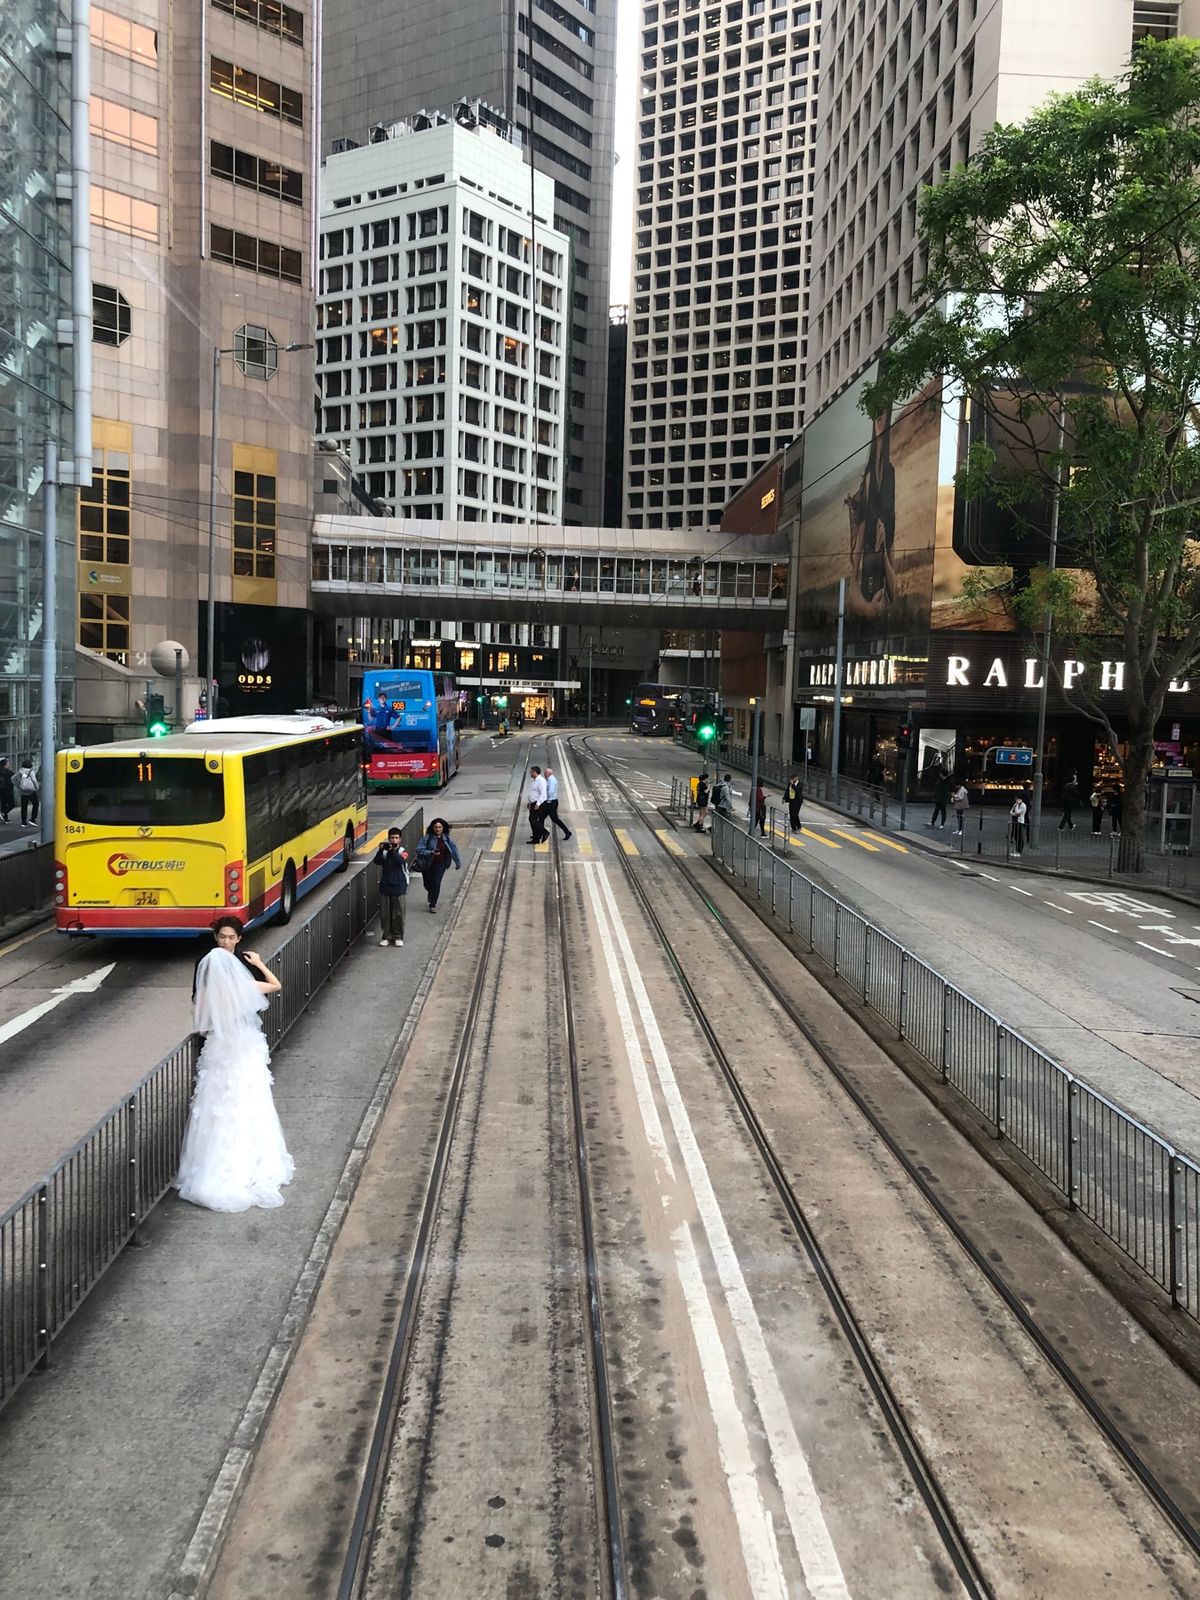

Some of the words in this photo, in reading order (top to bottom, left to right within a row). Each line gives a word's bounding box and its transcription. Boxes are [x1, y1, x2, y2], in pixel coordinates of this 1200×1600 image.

[238, 674, 272, 684] ODDS
[846, 659, 896, 685] LAUREN
[945, 655, 1127, 692] RALPH
[137, 763, 152, 782] 11
[64, 825, 86, 834] 1841
[118, 860, 165, 870] CITYBUS
